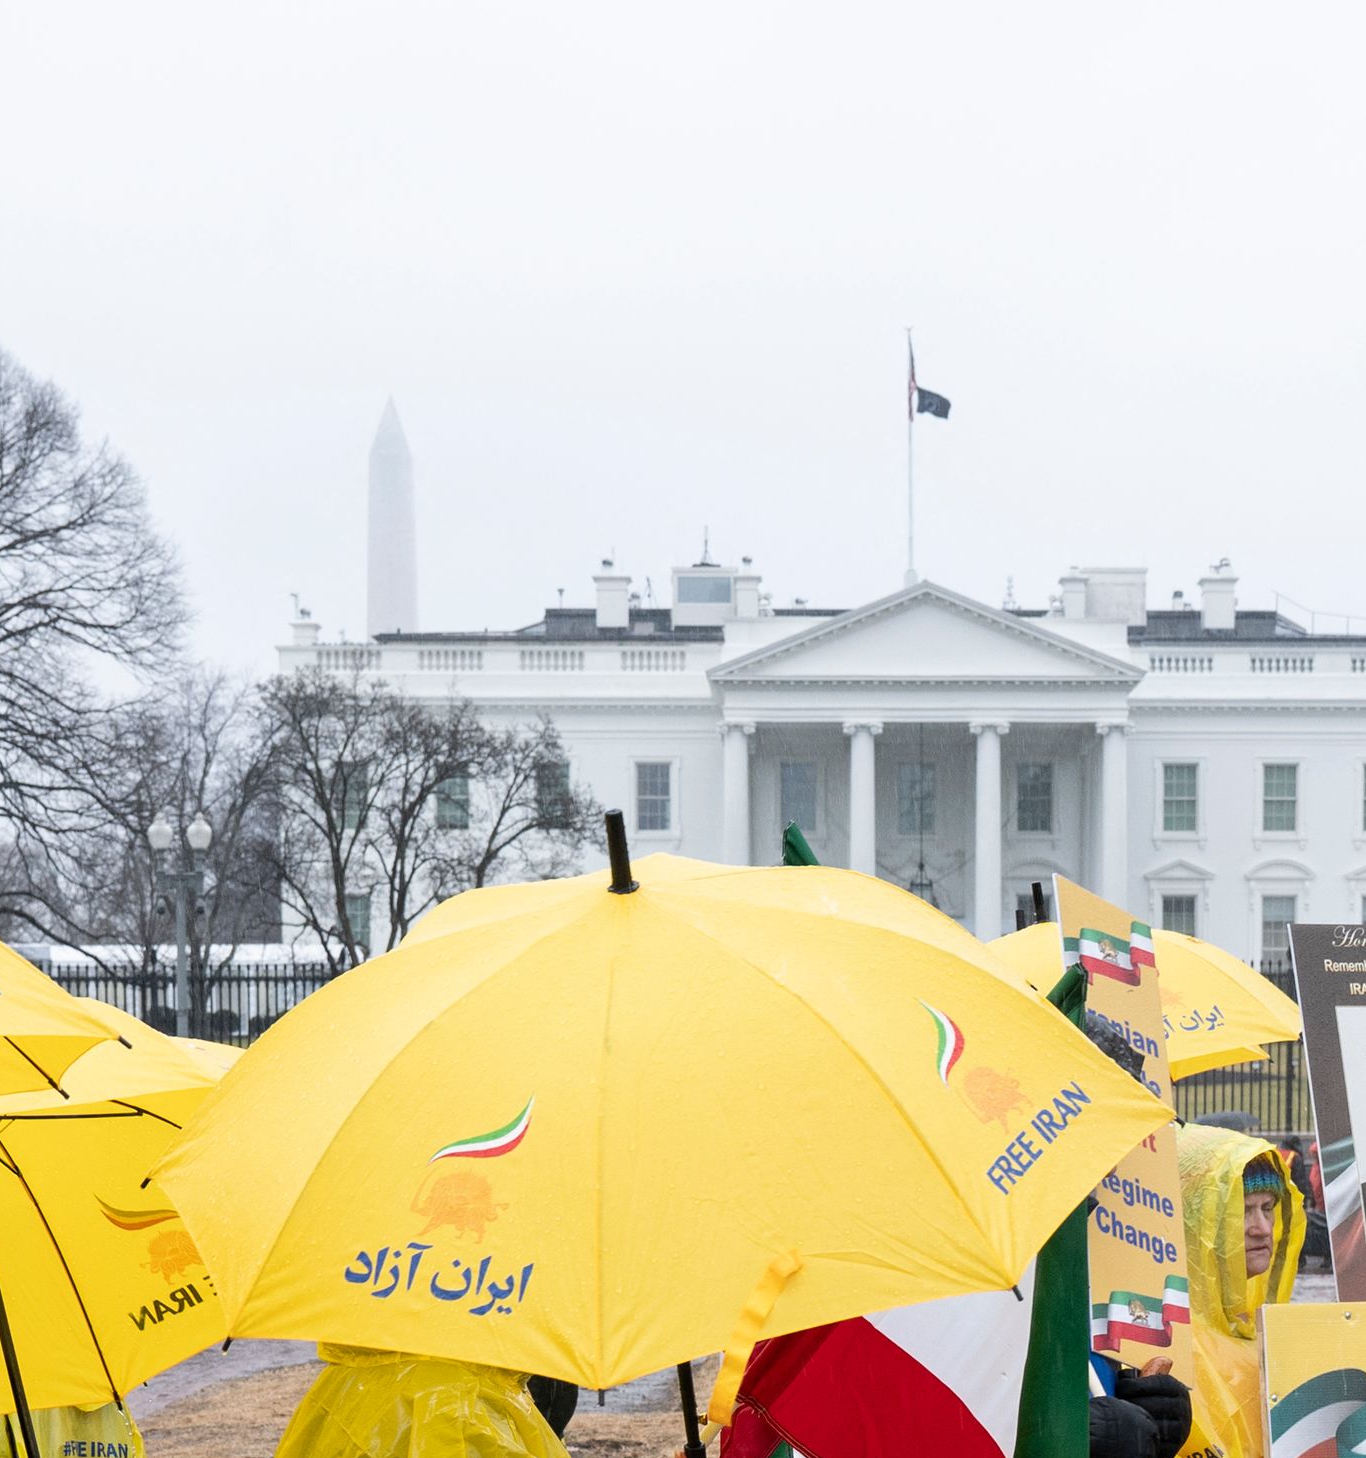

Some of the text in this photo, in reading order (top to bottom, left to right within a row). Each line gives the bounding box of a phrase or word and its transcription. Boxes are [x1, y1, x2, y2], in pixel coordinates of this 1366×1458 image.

[1179, 1005, 1225, 1031] ایران
[986, 1081, 1091, 1195] FREE IRAN
[1095, 1206, 1177, 1264] Change
[344, 1242, 534, 1316] ایران آزاد
[91, 1441, 129, 1458] IRAN
